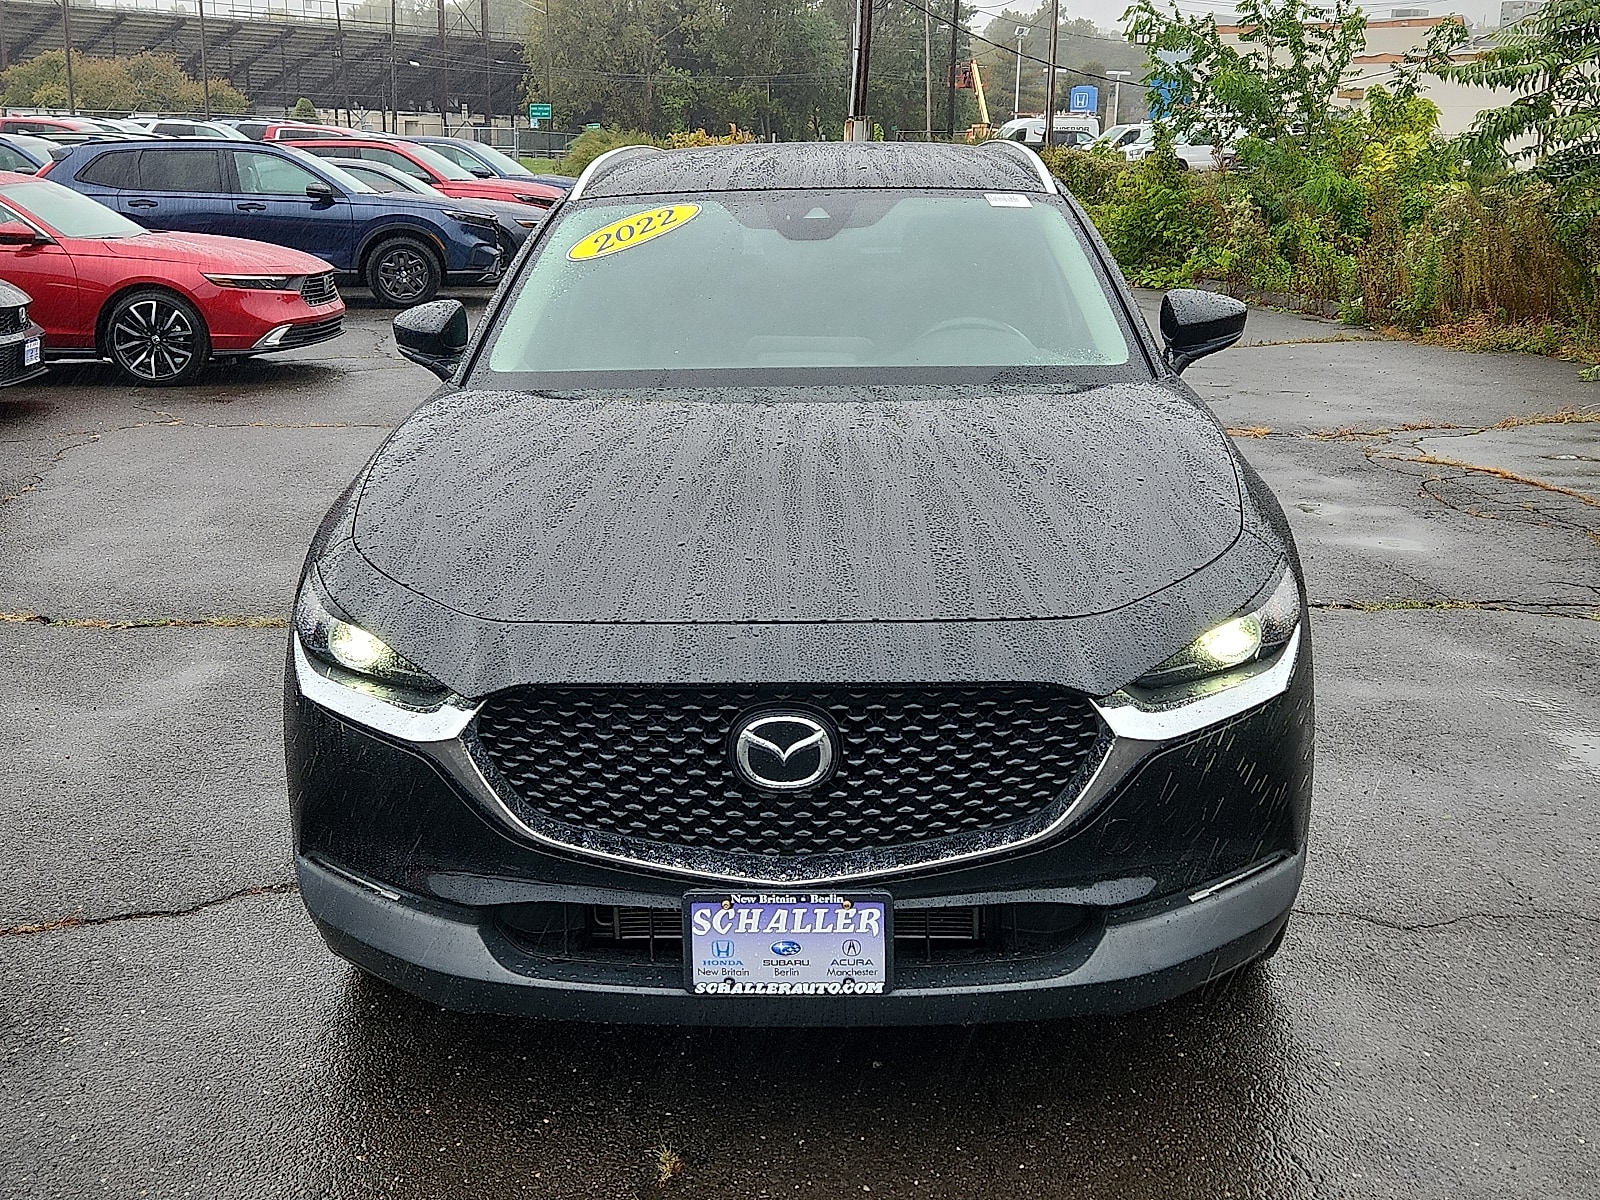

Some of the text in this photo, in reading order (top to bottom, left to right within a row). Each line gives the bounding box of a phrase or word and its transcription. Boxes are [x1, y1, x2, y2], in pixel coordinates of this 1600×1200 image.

[594, 209, 677, 253] 2022
[731, 894, 844, 904] New Britain Berlin
[692, 907, 881, 936] SCHALLER
[697, 967, 750, 977] New Britain
[774, 967, 800, 977] Berlin
[826, 967, 879, 977] Manchester
[694, 982, 884, 995] SCHALLERAUTO.COM
